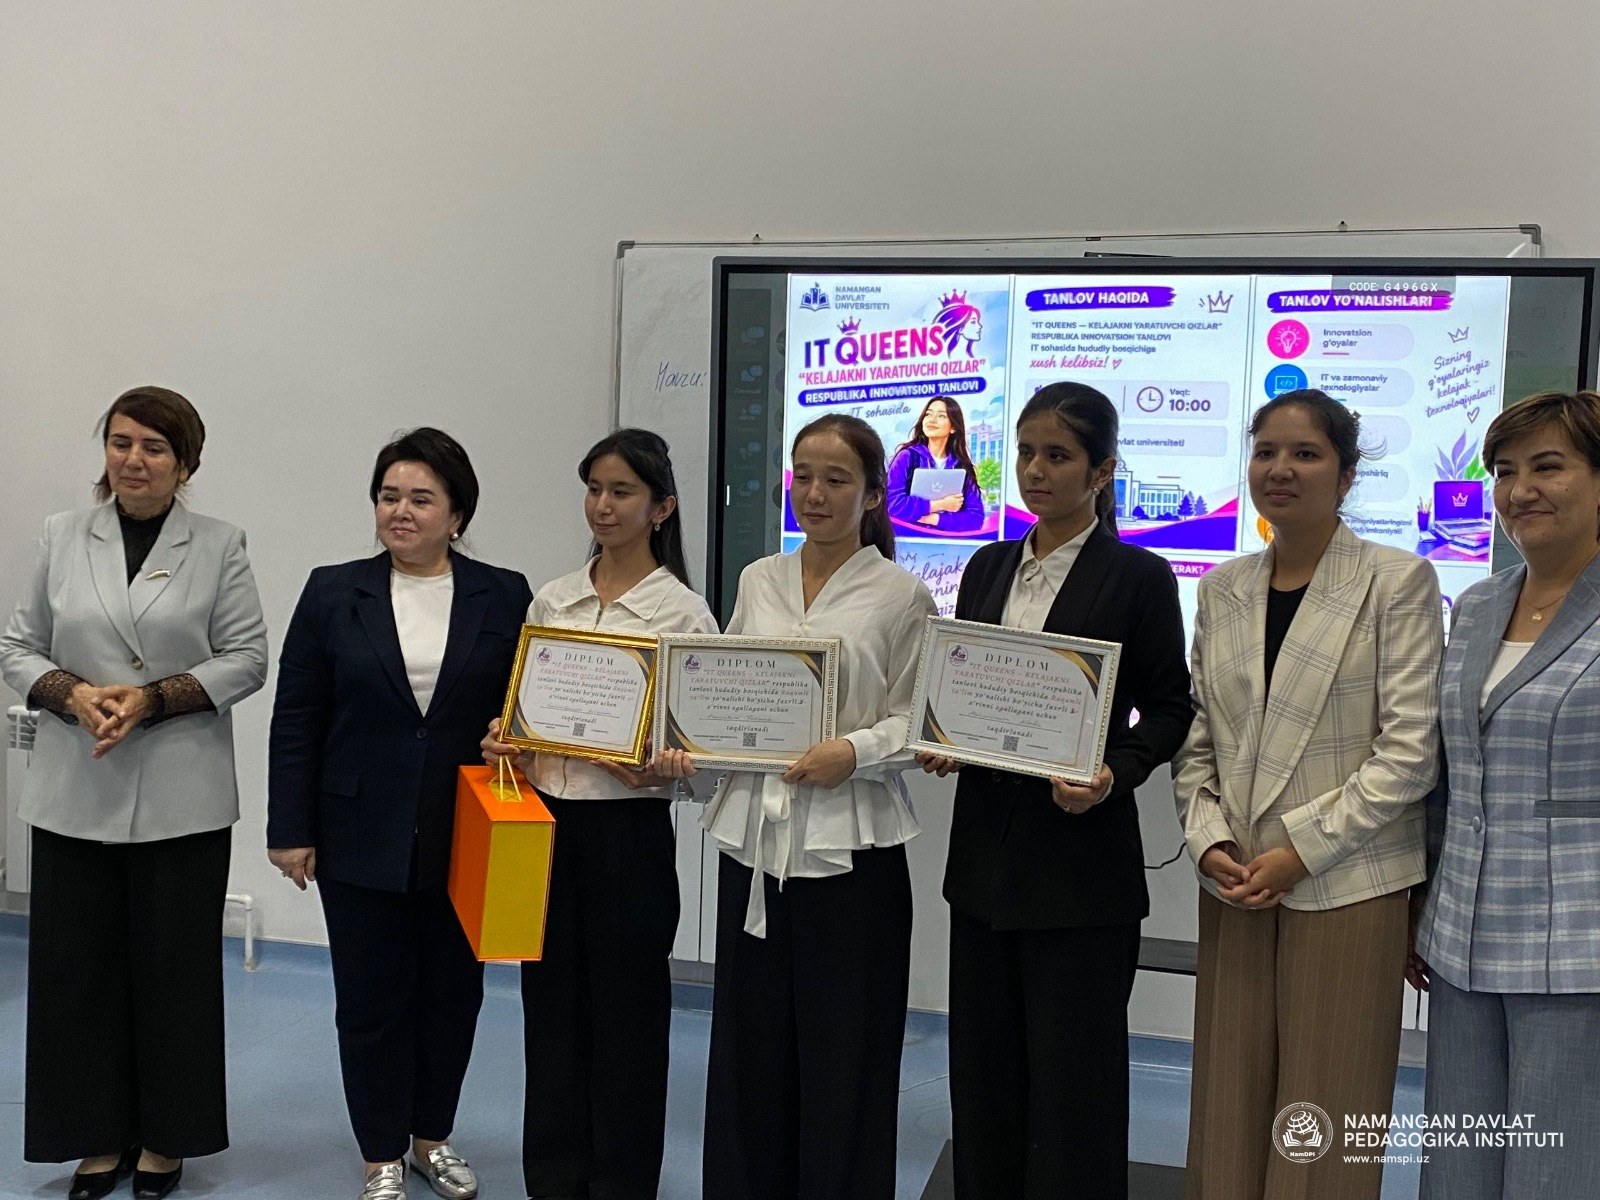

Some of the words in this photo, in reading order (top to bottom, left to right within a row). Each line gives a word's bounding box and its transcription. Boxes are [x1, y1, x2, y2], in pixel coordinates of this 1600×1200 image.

[1350, 283, 1378, 291] CODE:
[1043, 293, 1094, 304] TANLOV
[1098, 292, 1149, 303] HAQIDA
[1280, 295, 1330, 306] TANLOV
[1323, 329, 1372, 337] Innovatsion
[804, 338, 830, 368] IT
[835, 326, 944, 365] QUEENS
[1078, 345, 1110, 353] hududiy
[1113, 345, 1156, 354] bosqichiga
[1030, 354, 1056, 368] xush
[1061, 355, 1108, 368] kelibsiz!
[1434, 351, 1472, 370] Sizning
[871, 364, 938, 380] YARATUVCHI
[1343, 374, 1388, 383] zamonaviy
[806, 390, 866, 404] RESPUBLIKA
[870, 385, 935, 399] INNOVATSION
[938, 381, 978, 393] TANLOVI
[1170, 388, 1190, 397] Vaqt:
[1321, 384, 1379, 392] texnologiyalar
[1438, 378, 1471, 398] kelajak
[866, 402, 911, 418] sohasida
[1169, 400, 1211, 411] 10:00
[1137, 439, 1184, 447] universiteti
[565, 653, 614, 666] DIPLOM
[717, 659, 776, 668] DIPLOM
[985, 653, 1049, 671] DIPLOM
[984, 665, 1016, 676] QUEENS
[1025, 671, 1070, 684] KELAJAKNI
[954, 670, 1004, 682] YARATUVCHI
[1042, 684, 1082, 696] respublika
[979, 683, 1007, 694] hududiy
[1009, 688, 1049, 700] bosqichida
[987, 725, 1033, 738] taqdirlanadi
